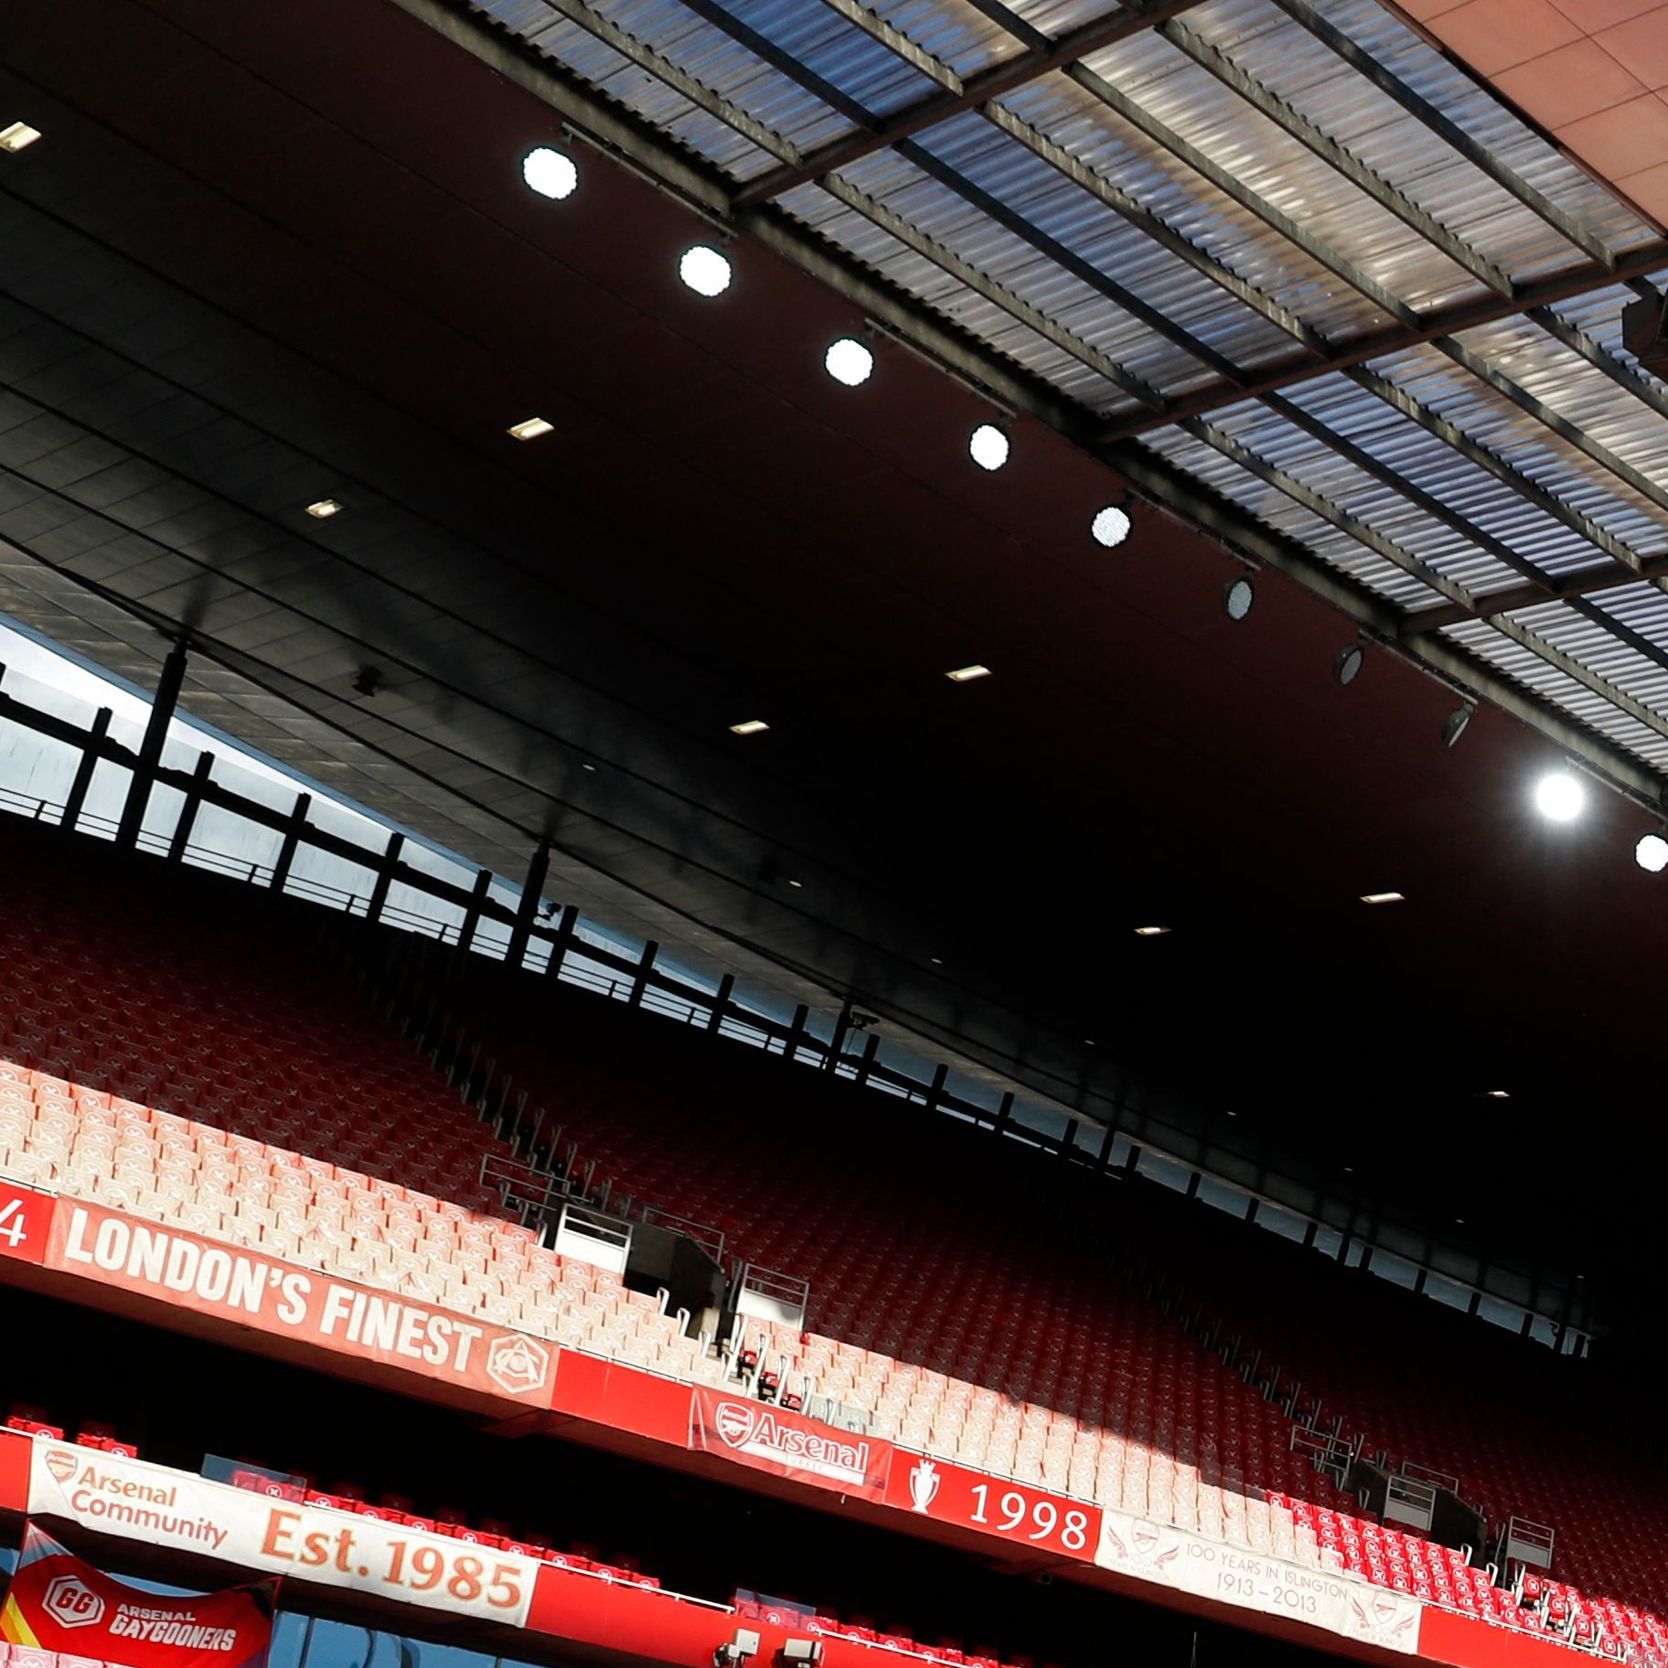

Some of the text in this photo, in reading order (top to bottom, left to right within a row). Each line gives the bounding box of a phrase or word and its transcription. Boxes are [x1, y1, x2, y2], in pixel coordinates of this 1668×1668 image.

[65, 1206, 483, 1375] LONDON'S FINEST
[753, 1412, 870, 1472] Arsenal
[78, 1465, 178, 1508] Arsenal
[71, 1489, 229, 1551] Community
[970, 1484, 1088, 1550] 1998
[260, 1508, 523, 1610] Est. 1985
[1221, 1550, 1261, 1576] YEARS
[1265, 1566, 1279, 1580] IN
[1284, 1569, 1348, 1599] ISLINGTON
[109, 1613, 237, 1652] GAYGOONERS
[116, 1603, 197, 1622] ARSENAL
